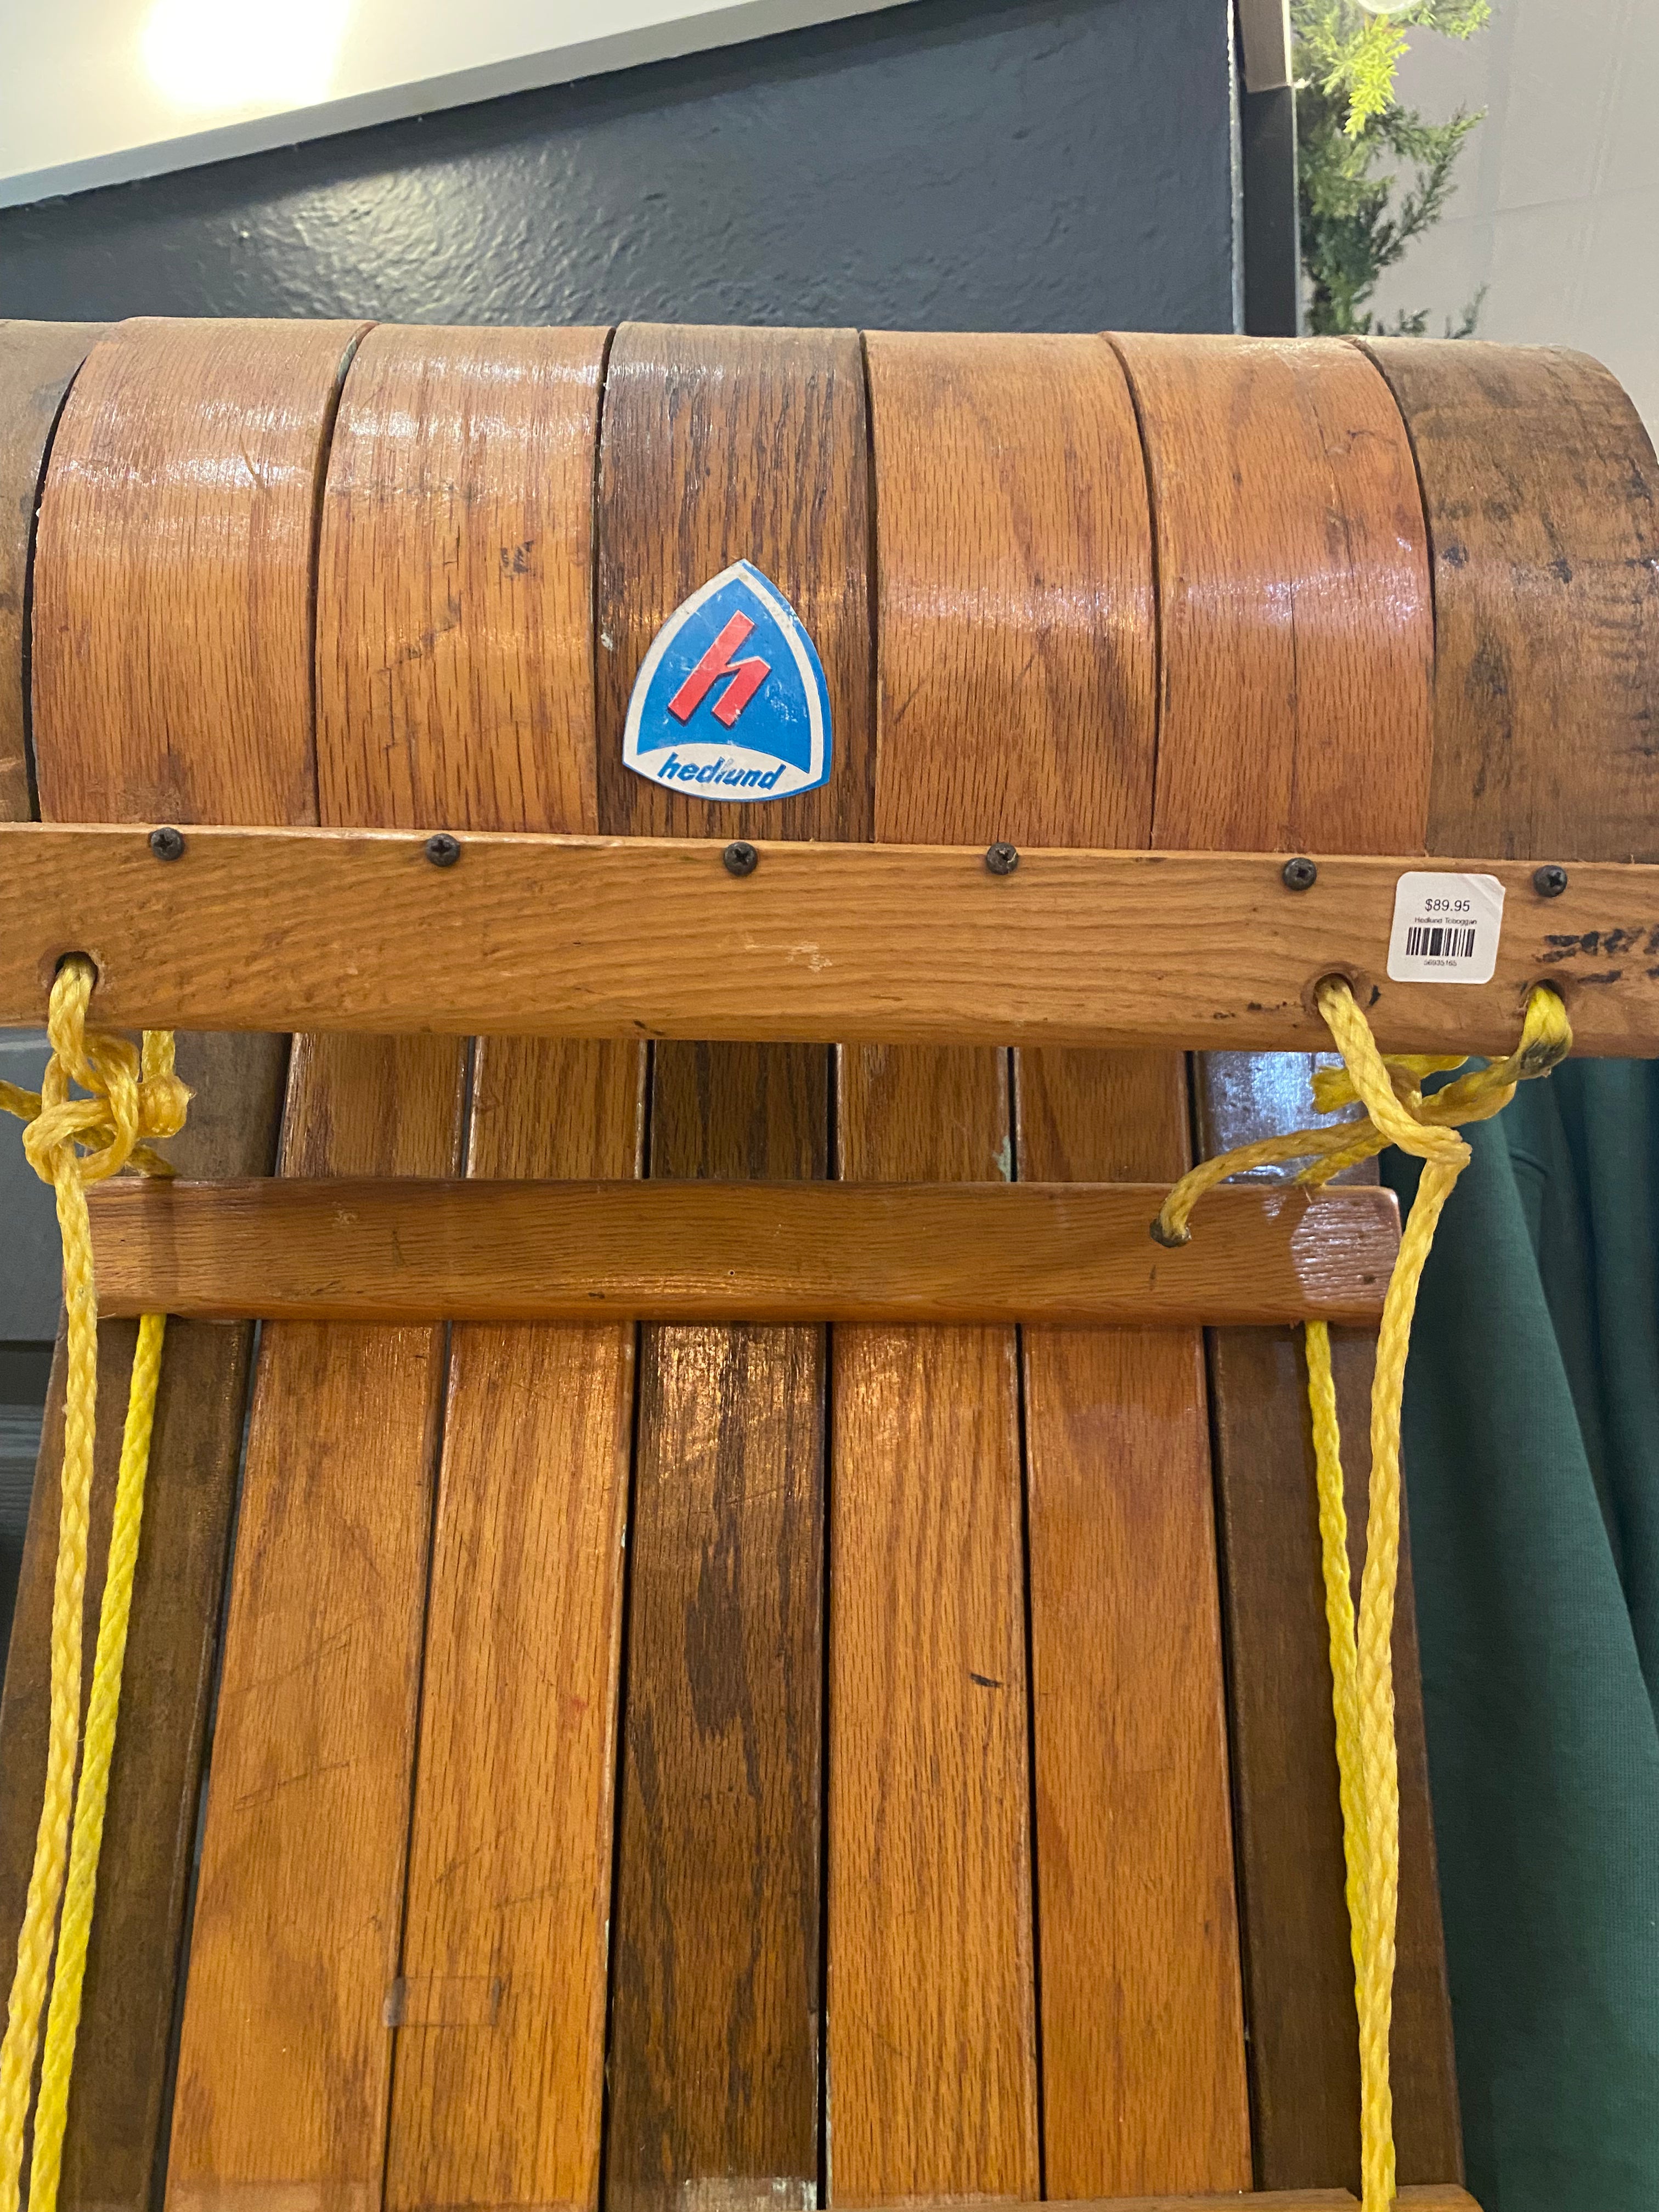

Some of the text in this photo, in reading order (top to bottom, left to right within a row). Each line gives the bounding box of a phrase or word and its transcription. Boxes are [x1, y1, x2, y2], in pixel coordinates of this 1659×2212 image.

[668, 610, 771, 730] h
[658, 752, 786, 789] hedlund
[1425, 899, 1470, 912] $89.95
[1445, 917, 1477, 926] Toboggan
